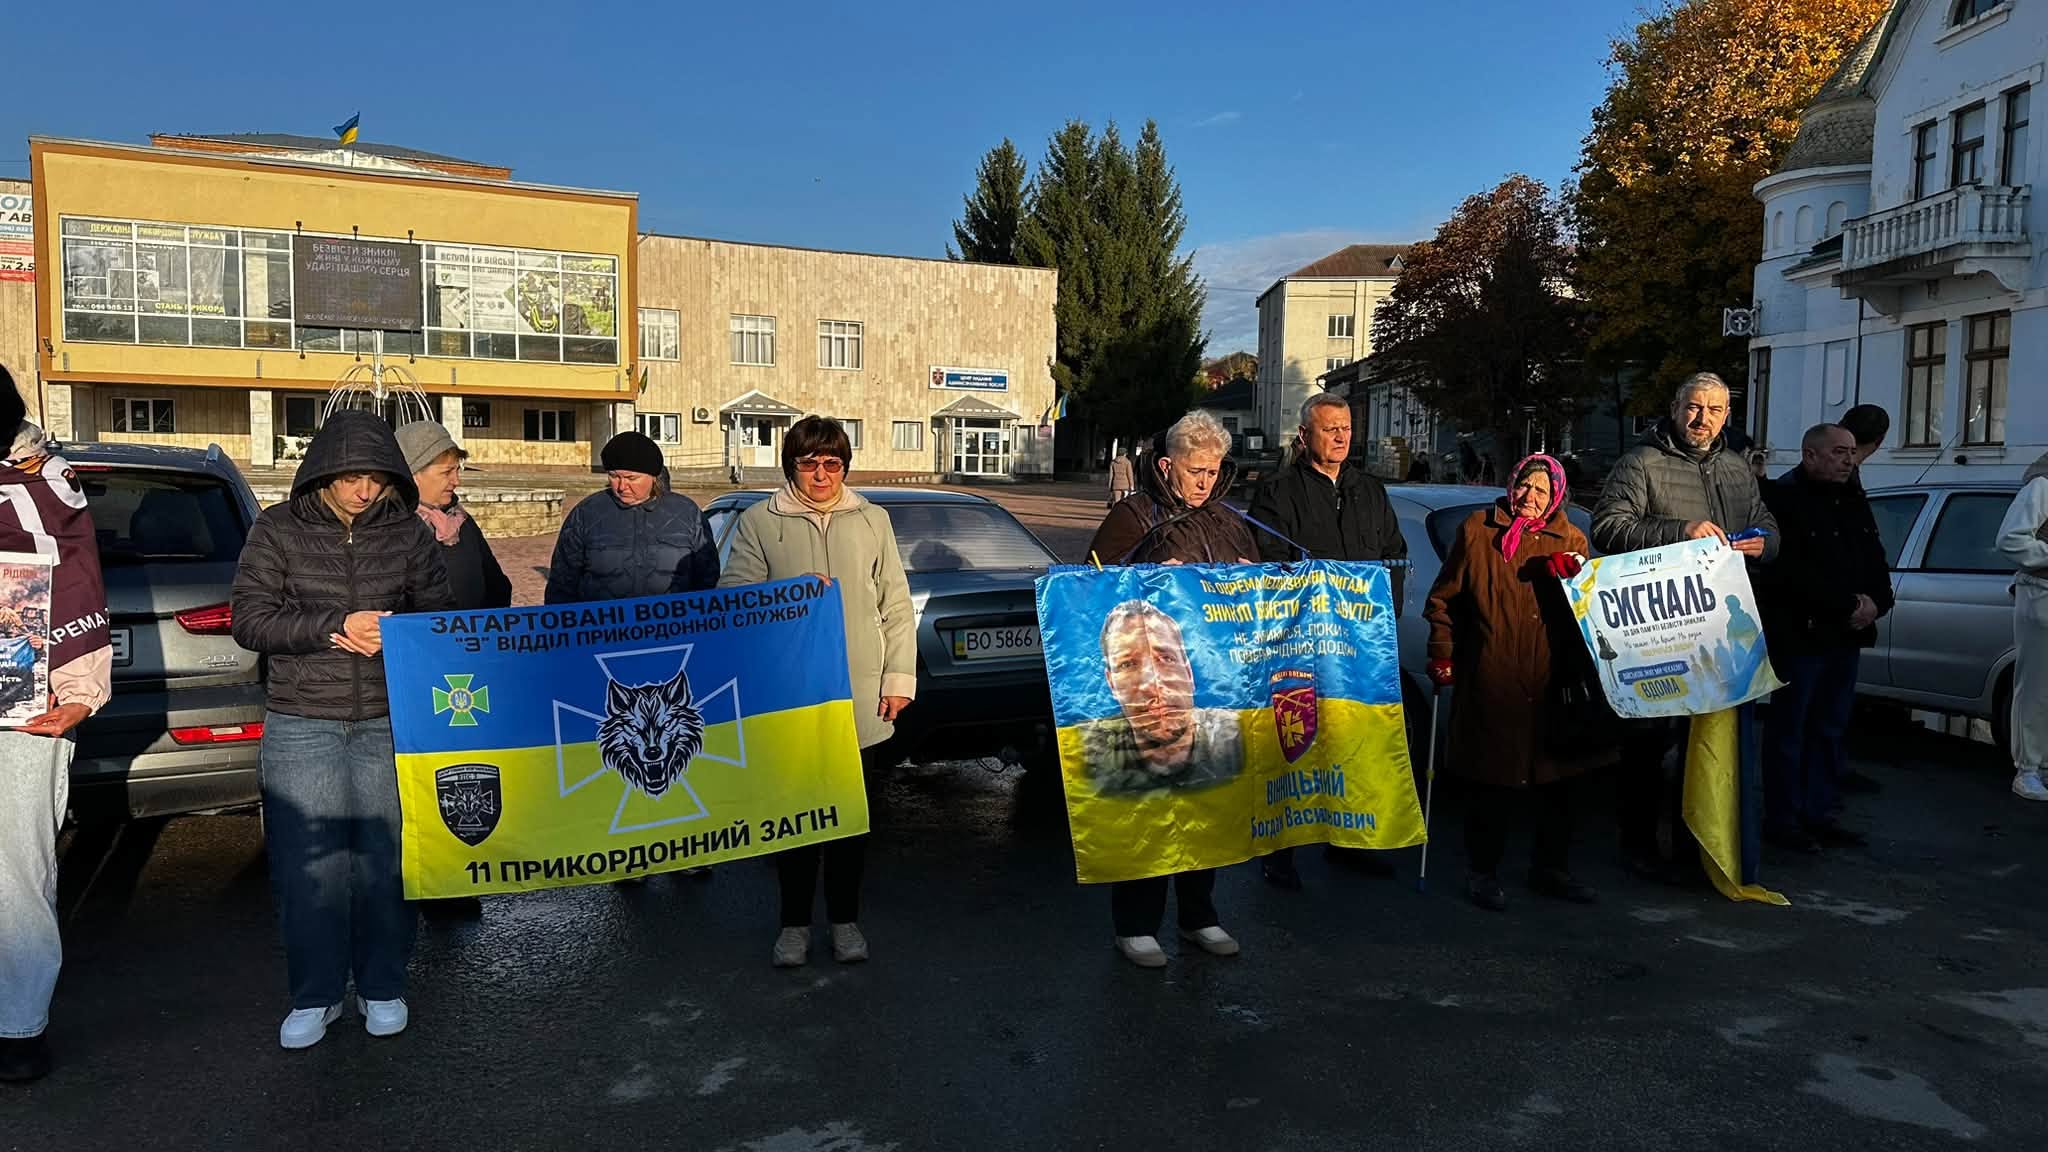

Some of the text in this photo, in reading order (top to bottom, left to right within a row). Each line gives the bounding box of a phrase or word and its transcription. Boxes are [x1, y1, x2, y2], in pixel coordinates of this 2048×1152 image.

[312, 244, 396, 257] БЕЗВІСТИ ЗНИКЛІ
[305, 260, 335, 272] УДАРІ
[379, 266, 410, 277] СЕРЦЯ
[1638, 552, 1663, 567] АКЦІЯ
[431, 580, 825, 634] ЗАГАРТОВАНІ ВОВЧАНСЬКОМ
[1598, 573, 1718, 629] СИГНАЛЬ
[455, 604, 809, 653] "З" ВІДДІЛ ПРИКОРДОННОЇ СЛУЖБИ
[996, 628, 1033, 648] 5866
[1640, 676, 1681, 700] ВДОМА
[465, 805, 839, 884] 11 ПРИКОРДОННИЙ ЗАГІН
